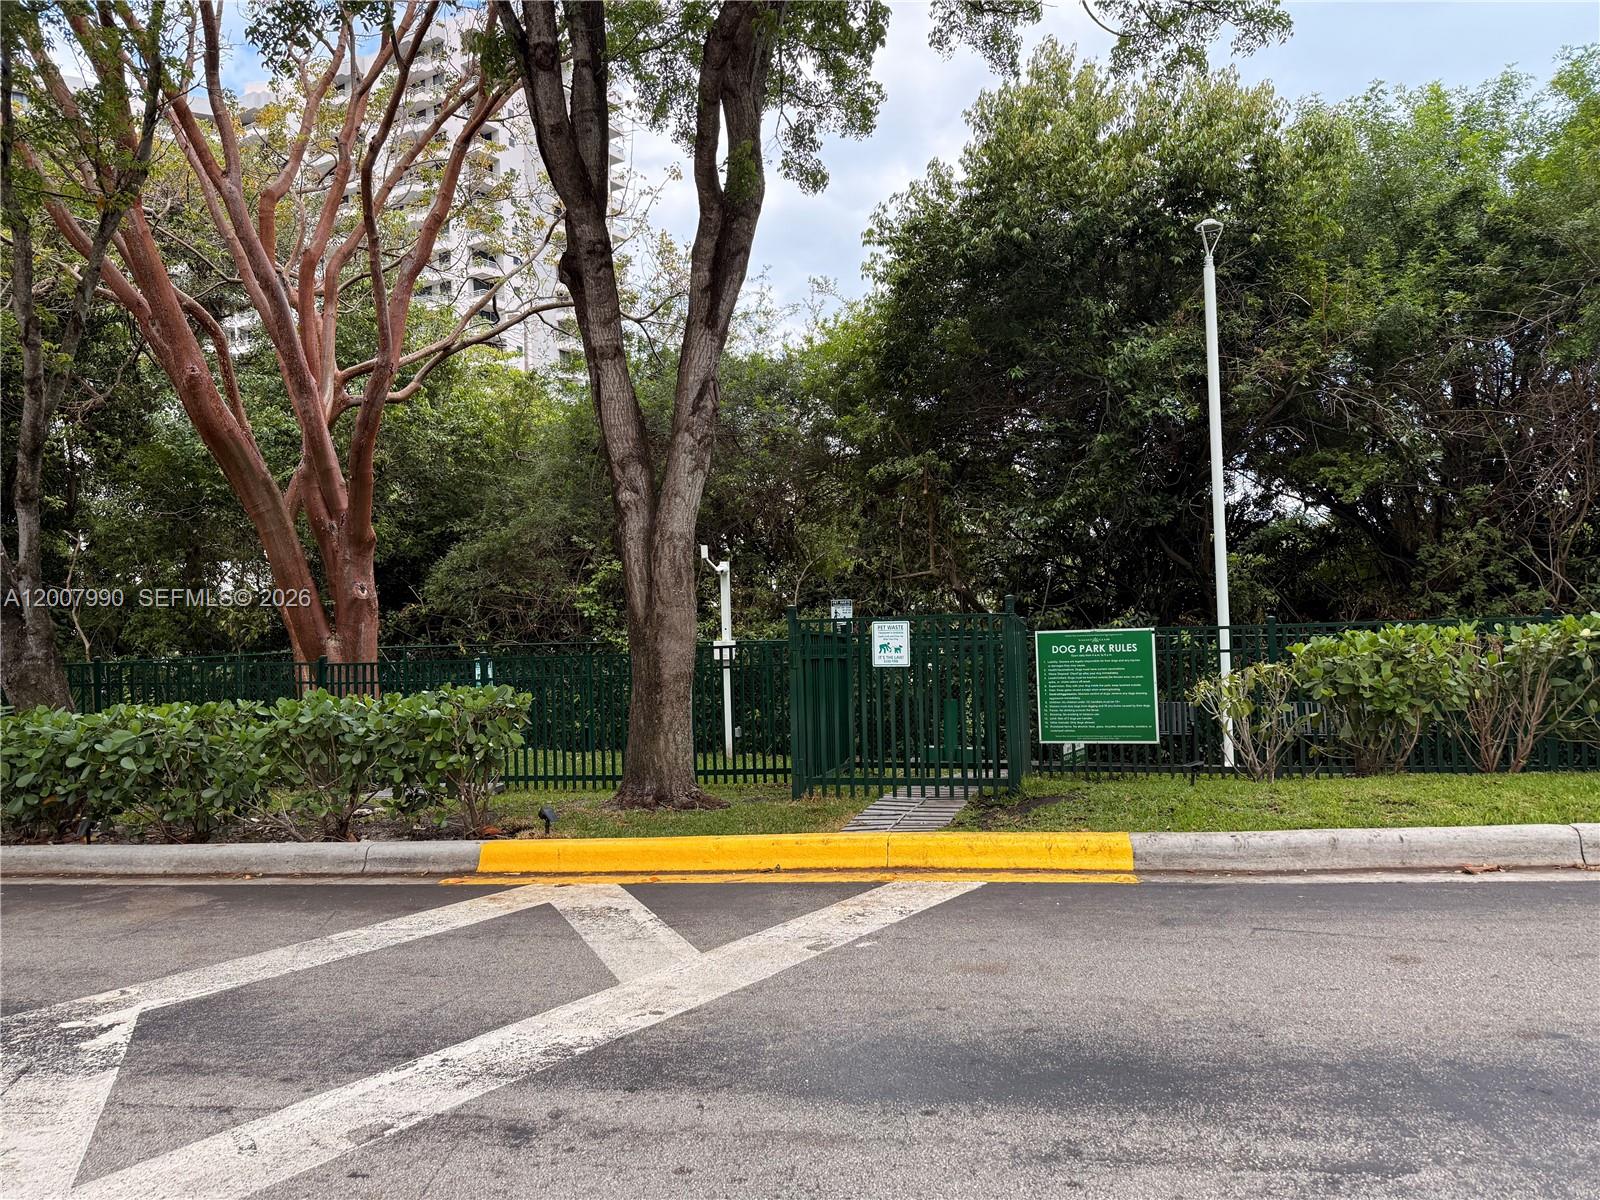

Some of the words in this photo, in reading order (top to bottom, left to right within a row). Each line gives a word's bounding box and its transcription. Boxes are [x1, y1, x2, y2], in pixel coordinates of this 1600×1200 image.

[1052, 645, 1076, 654] DOG
[1079, 644, 1106, 653] PARK
[1109, 643, 1138, 653] RULES
